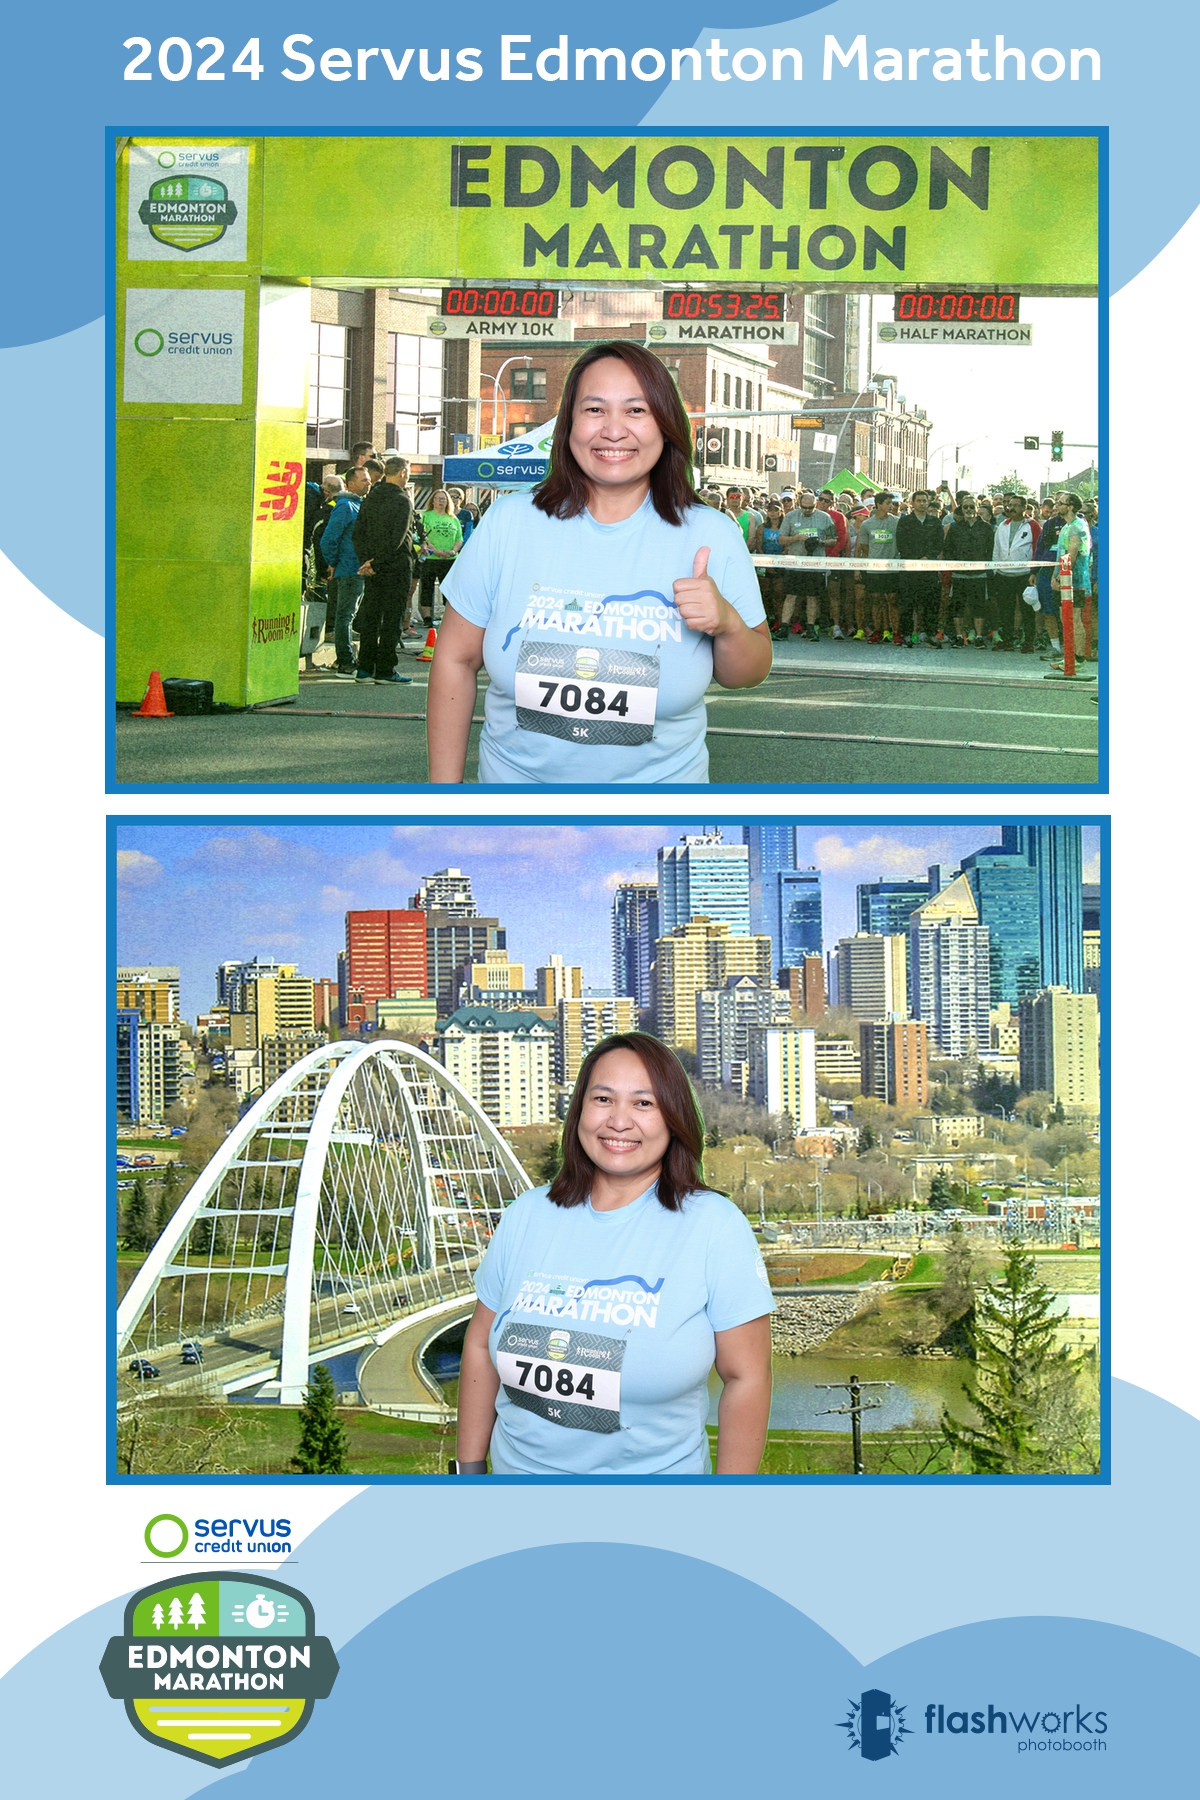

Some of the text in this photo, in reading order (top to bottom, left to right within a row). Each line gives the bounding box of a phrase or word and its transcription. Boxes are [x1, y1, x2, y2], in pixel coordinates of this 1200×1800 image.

[178, 151, 220, 162] servus
[451, 145, 990, 211] EDMONTON
[149, 203, 227, 214] EDMONTON
[160, 214, 216, 222] MARATHON
[524, 224, 906, 271] MARATHON
[466, 321, 554, 336] ARMY 10K
[678, 325, 785, 340] MARATHON
[900, 327, 1031, 341] HALF MARATHON
[168, 332, 233, 345] servus
[168, 346, 233, 355] credit union
[496, 465, 546, 475] servus
[540, 586, 563, 594] servus
[563, 588, 584, 596] credit
[526, 594, 683, 621] 2024 EDMONTON
[519, 608, 682, 643] MARATHON
[538, 681, 629, 717] 7084
[572, 727, 589, 738] 5K
[520, 1280, 661, 1306] 2024 EDMONTON
[510, 1292, 659, 1329] MARATHON
[515, 1360, 595, 1401] 7084
[547, 1407, 562, 1419] 5K
